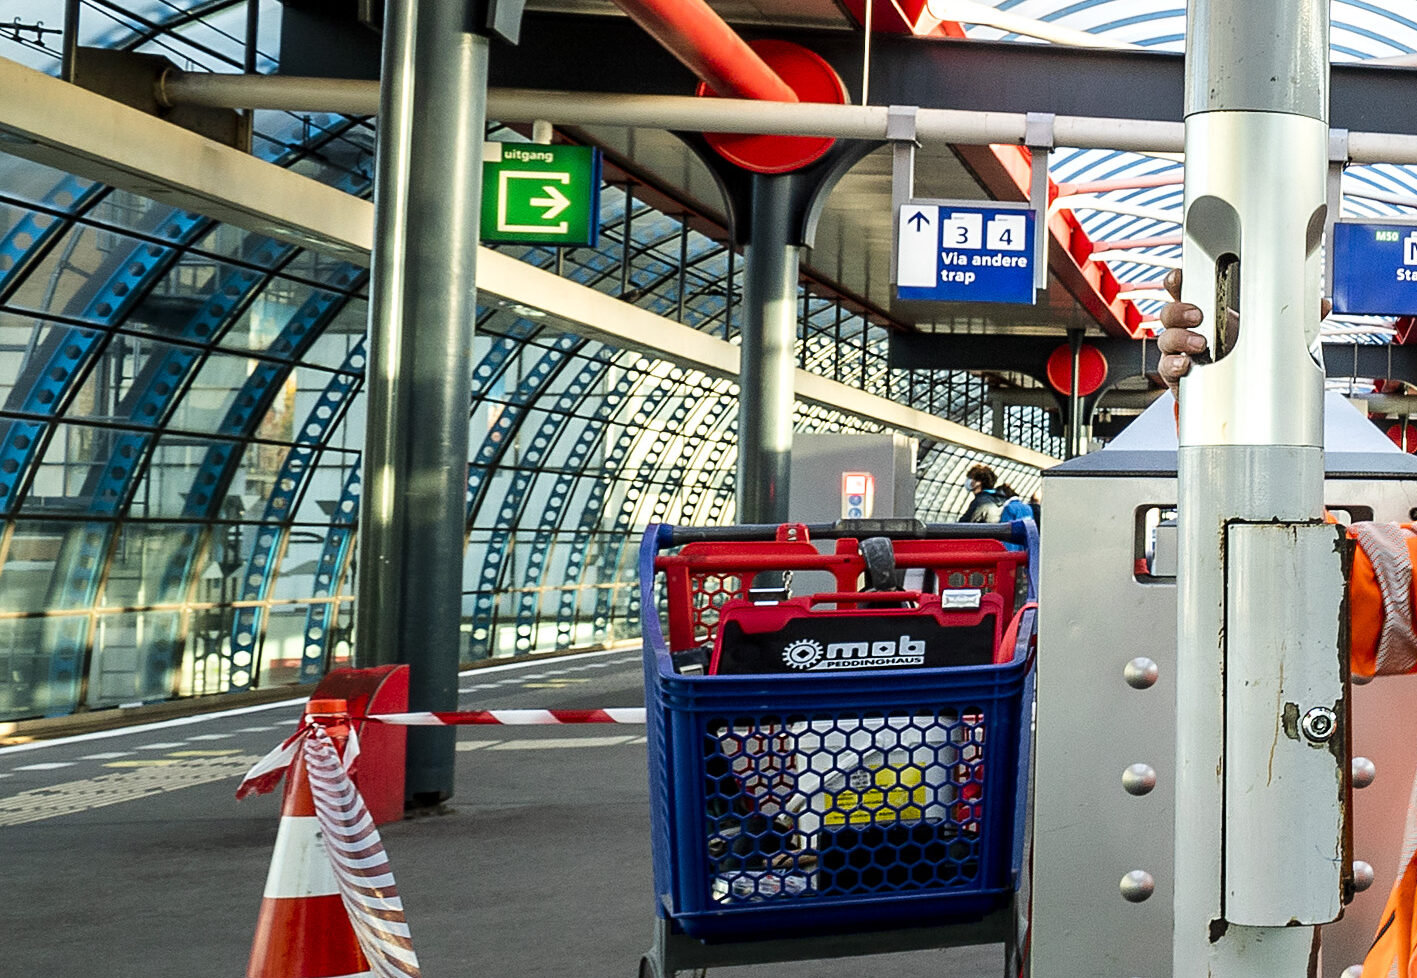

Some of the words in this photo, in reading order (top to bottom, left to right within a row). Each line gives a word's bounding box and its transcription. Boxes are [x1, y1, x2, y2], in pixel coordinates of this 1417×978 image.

[504, 149, 554, 163] uitgang
[955, 226, 969, 244] 3
[999, 228, 1013, 245] 4
[1375, 231, 1399, 241] M50
[941, 252, 968, 266] Via
[972, 253, 1028, 268] andere
[941, 270, 976, 285] trap
[826, 635, 926, 659] mob
[827, 657, 922, 668] PEDDINGHAUS
